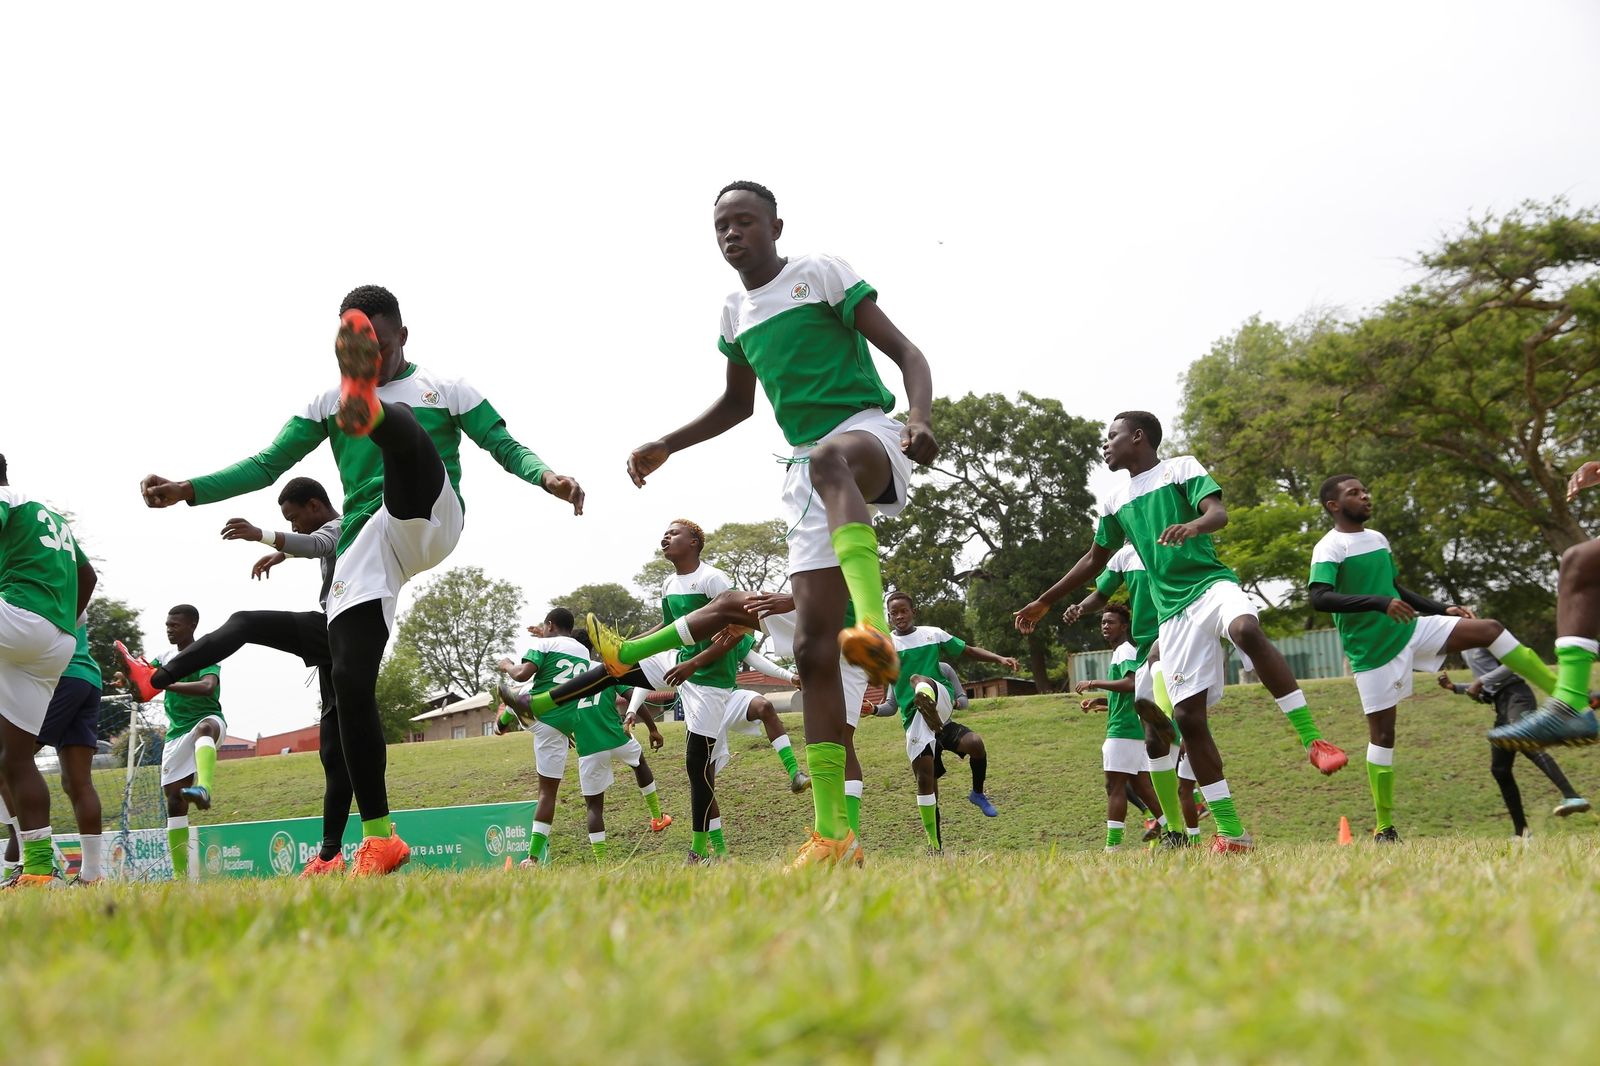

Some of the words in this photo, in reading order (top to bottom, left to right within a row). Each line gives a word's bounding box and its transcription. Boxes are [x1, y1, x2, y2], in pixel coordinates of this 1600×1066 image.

[37, 509, 76, 562] 34
[505, 825, 526, 839] Betis
[299, 841, 323, 864] Bet
[410, 843, 463, 856] MBABWE
[506, 839, 530, 852] Acade
